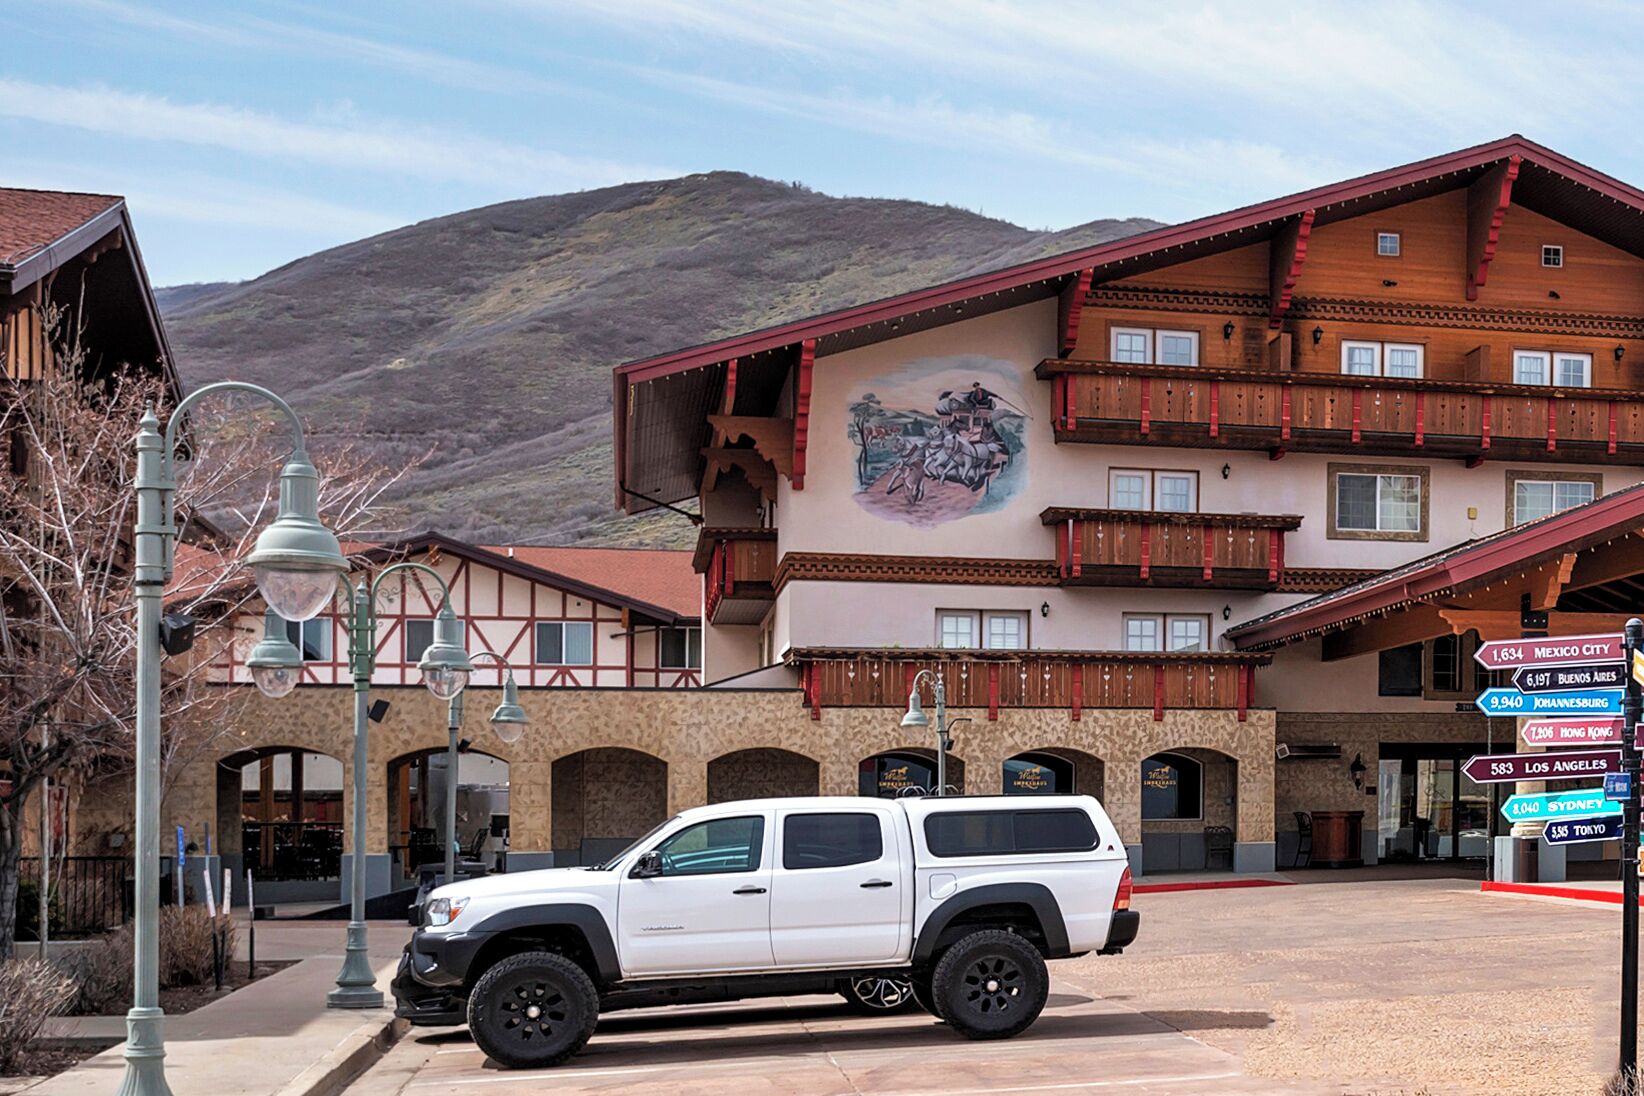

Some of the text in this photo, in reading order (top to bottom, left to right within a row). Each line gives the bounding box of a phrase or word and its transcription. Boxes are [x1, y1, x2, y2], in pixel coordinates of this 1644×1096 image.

[1492, 647, 1524, 662] 1,634
[1534, 647, 1579, 659] MEXICO
[1526, 671, 1617, 688] 6,197 BUENOS AIRES
[1490, 696, 1609, 710] 9,940 JOHANNESBURG
[1530, 726, 1613, 740] 7,206 HONG KONG
[1490, 759, 1608, 776] 583 LOS ANGELES
[1512, 799, 1604, 816] 8,040 SYDNEY
[1573, 823, 1606, 837] TOKYO
